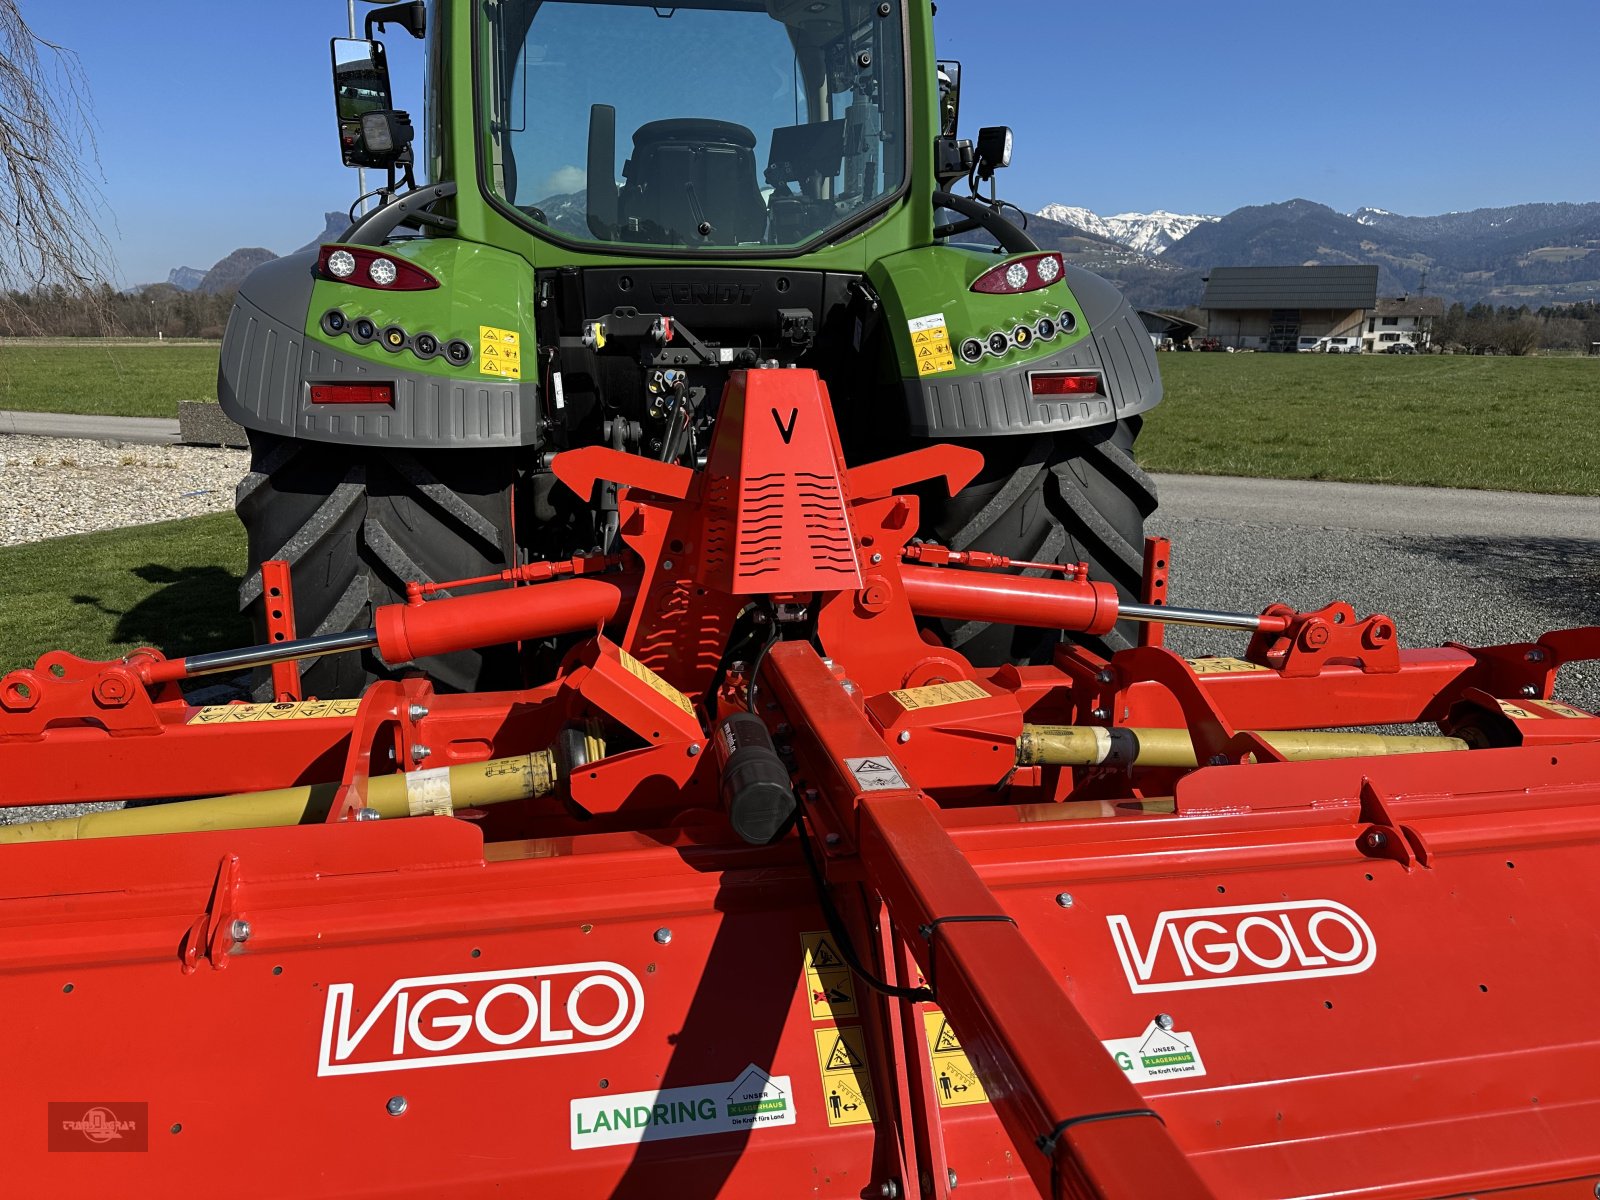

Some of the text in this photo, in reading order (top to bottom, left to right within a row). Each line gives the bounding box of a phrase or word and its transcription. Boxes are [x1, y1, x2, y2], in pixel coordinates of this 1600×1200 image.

[649, 282, 761, 306] FENDT
[1109, 904, 1369, 986] VIGOLO
[325, 968, 634, 1066] VIGOLO
[1152, 1055, 1191, 1064] LAGERHAUS
[1158, 1067, 1171, 1075] Kraft
[742, 1091, 769, 1100] UNSER
[737, 1102, 783, 1112] LAGERHAUS
[577, 1098, 717, 1135] LANDRING
[742, 1116, 757, 1124] Kraft
[770, 1113, 785, 1121] Land
